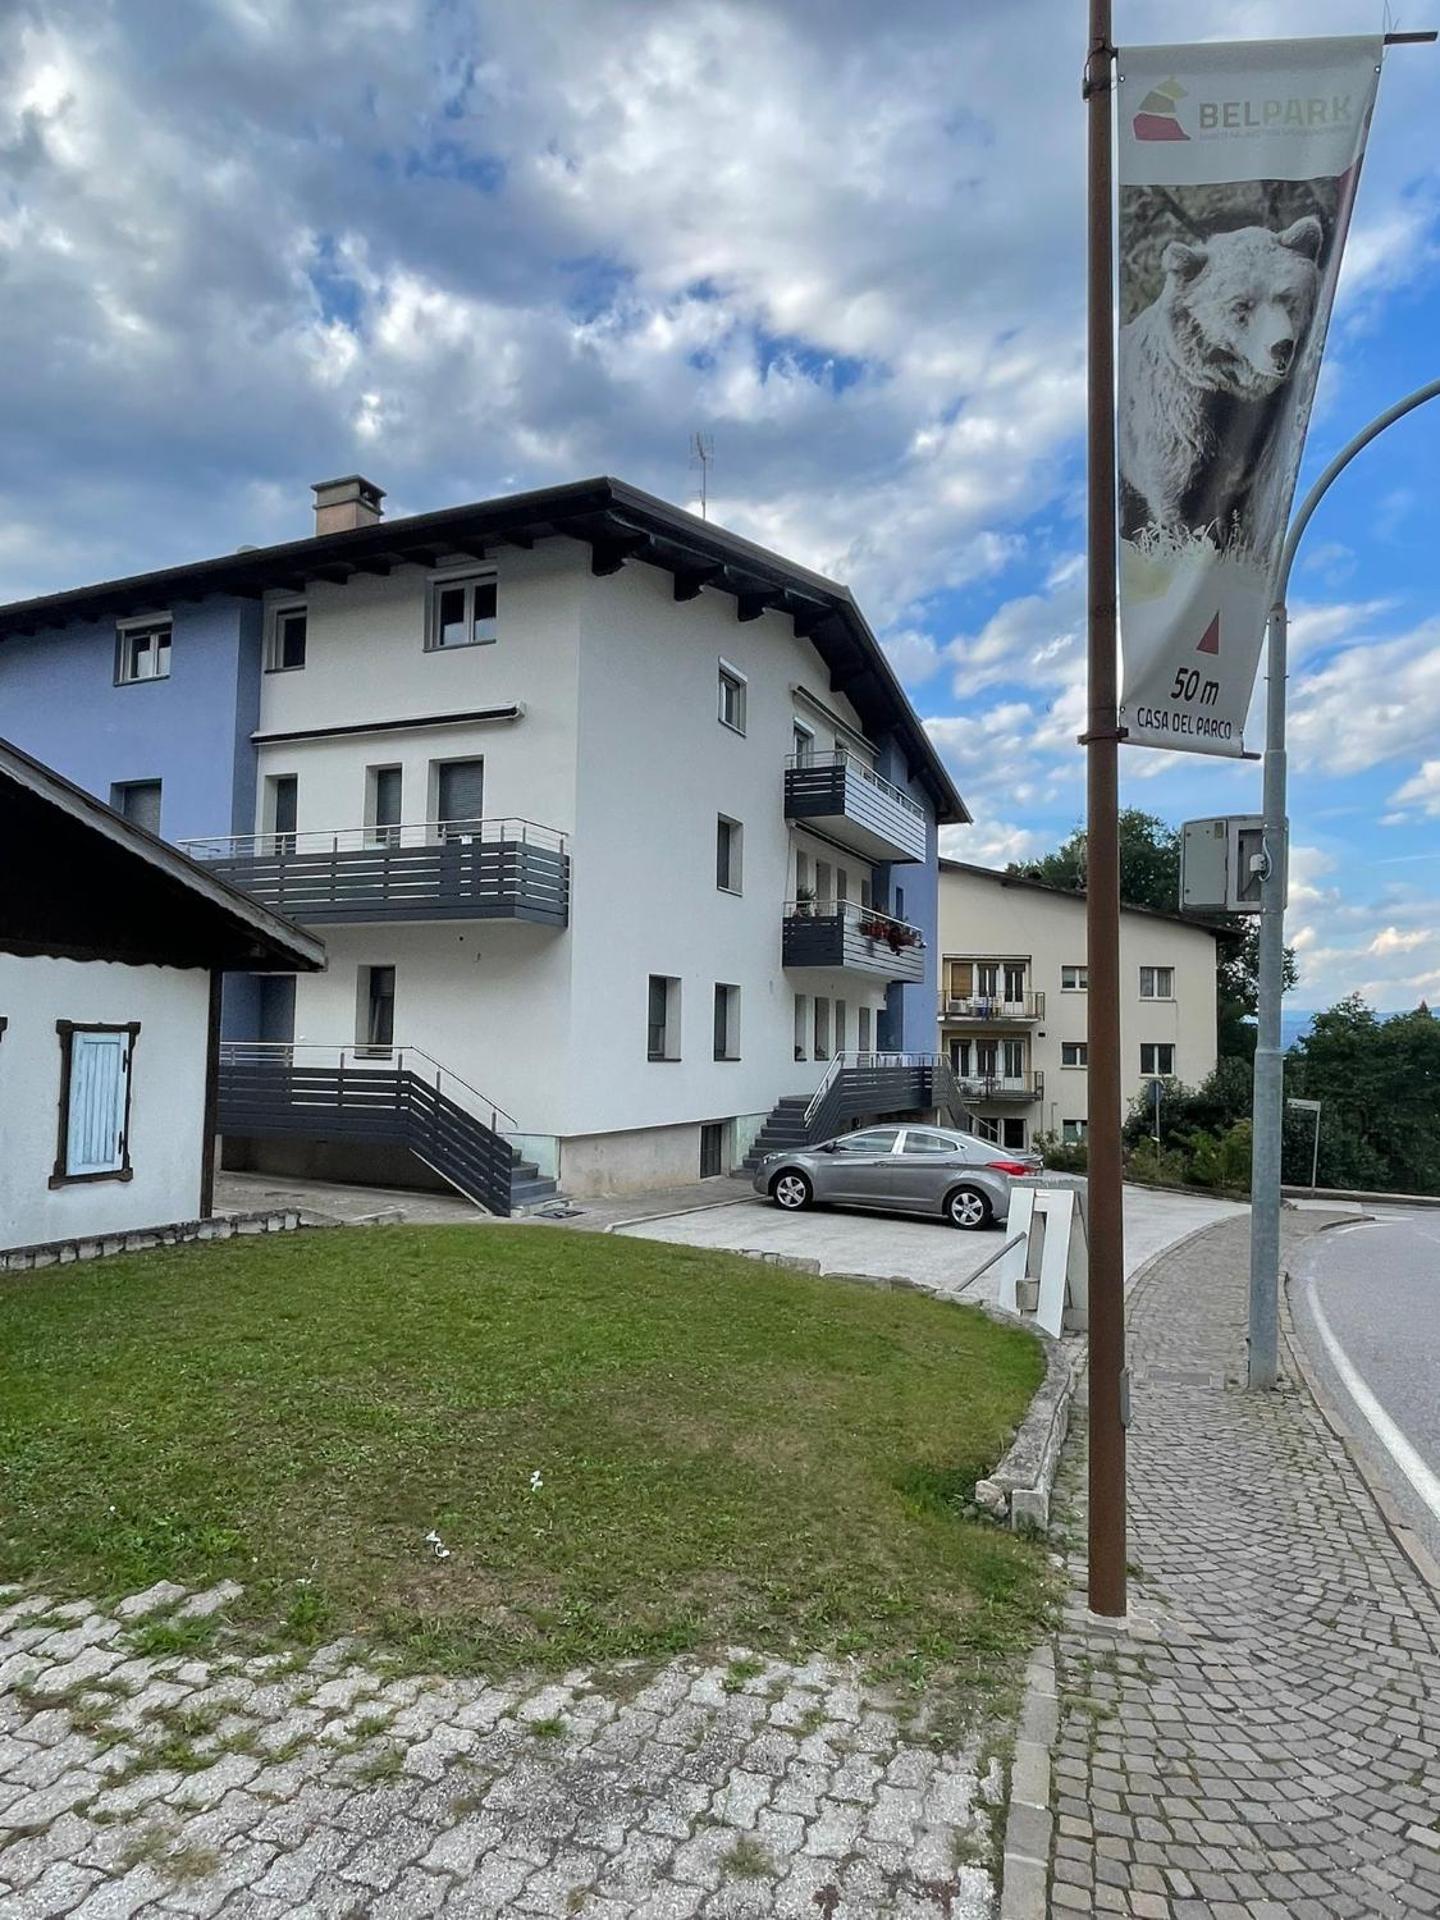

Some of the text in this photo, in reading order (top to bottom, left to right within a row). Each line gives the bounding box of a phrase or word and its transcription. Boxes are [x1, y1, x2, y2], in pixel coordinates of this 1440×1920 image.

[1199, 96, 1350, 129] BELPARK
[1171, 668, 1219, 706] 50 m
[1138, 708, 1231, 740] CASA DEL PARCO
